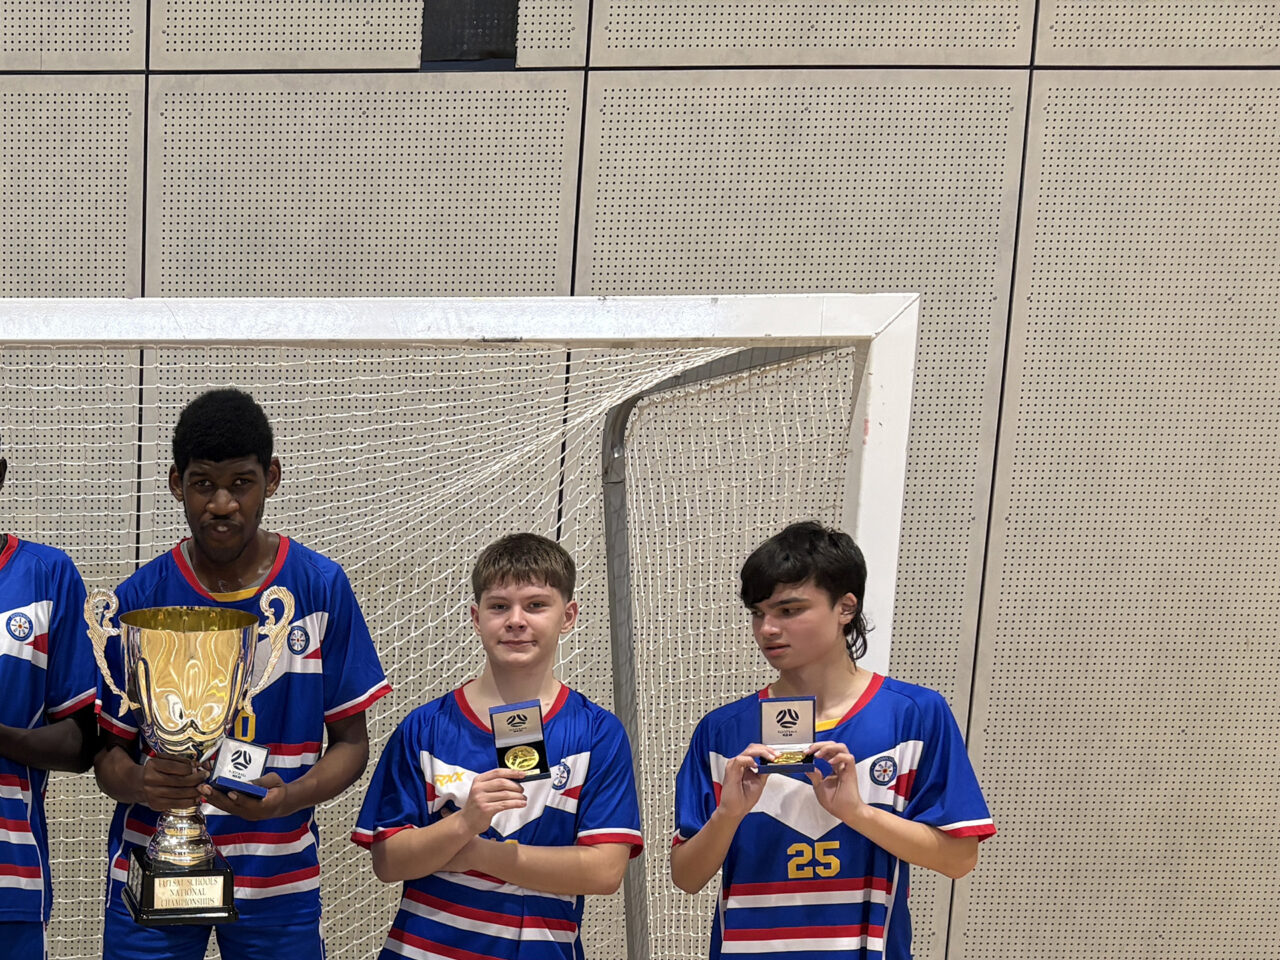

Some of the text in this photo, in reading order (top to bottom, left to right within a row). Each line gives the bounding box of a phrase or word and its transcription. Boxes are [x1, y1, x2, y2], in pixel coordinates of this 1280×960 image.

[434, 771, 465, 787] RXX
[787, 841, 841, 879] 25
[169, 887, 207, 897] NATIONAL
[160, 896, 216, 908] CHAMPIONSHIPS
